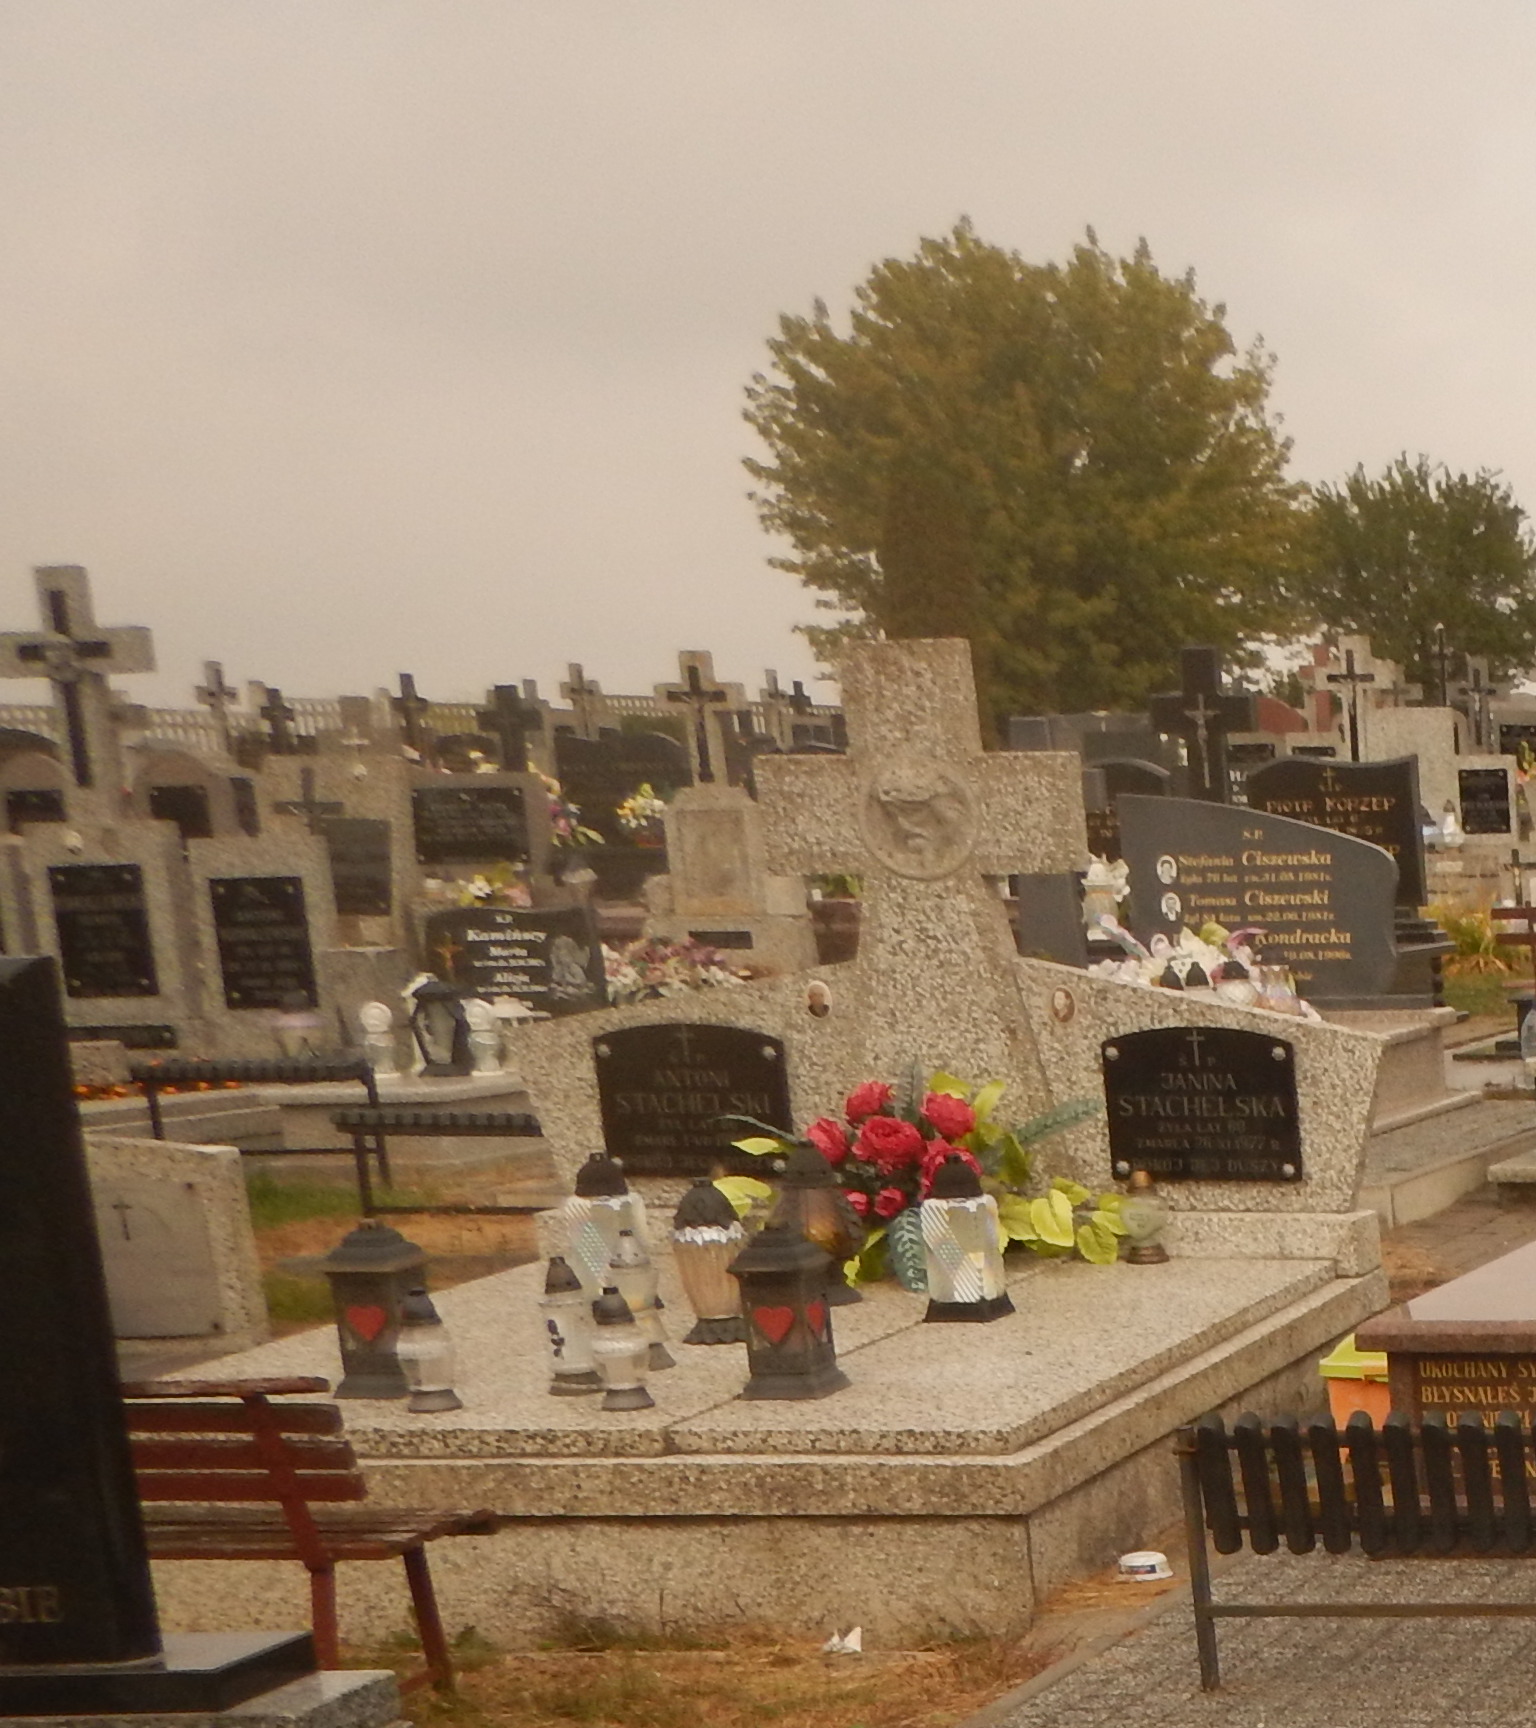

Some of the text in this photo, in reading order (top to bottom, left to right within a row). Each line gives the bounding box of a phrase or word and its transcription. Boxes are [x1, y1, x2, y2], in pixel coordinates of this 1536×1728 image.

[1241, 849, 1333, 867] Ciszewska
[1244, 889, 1330, 906] Ciszewski
[1160, 1072, 1238, 1090] JANINA
[614, 1092, 772, 1114] STACHELSKI
[1118, 1095, 1286, 1118] STACHELSKA
[1418, 1360, 1511, 1380] UKOCHANY
